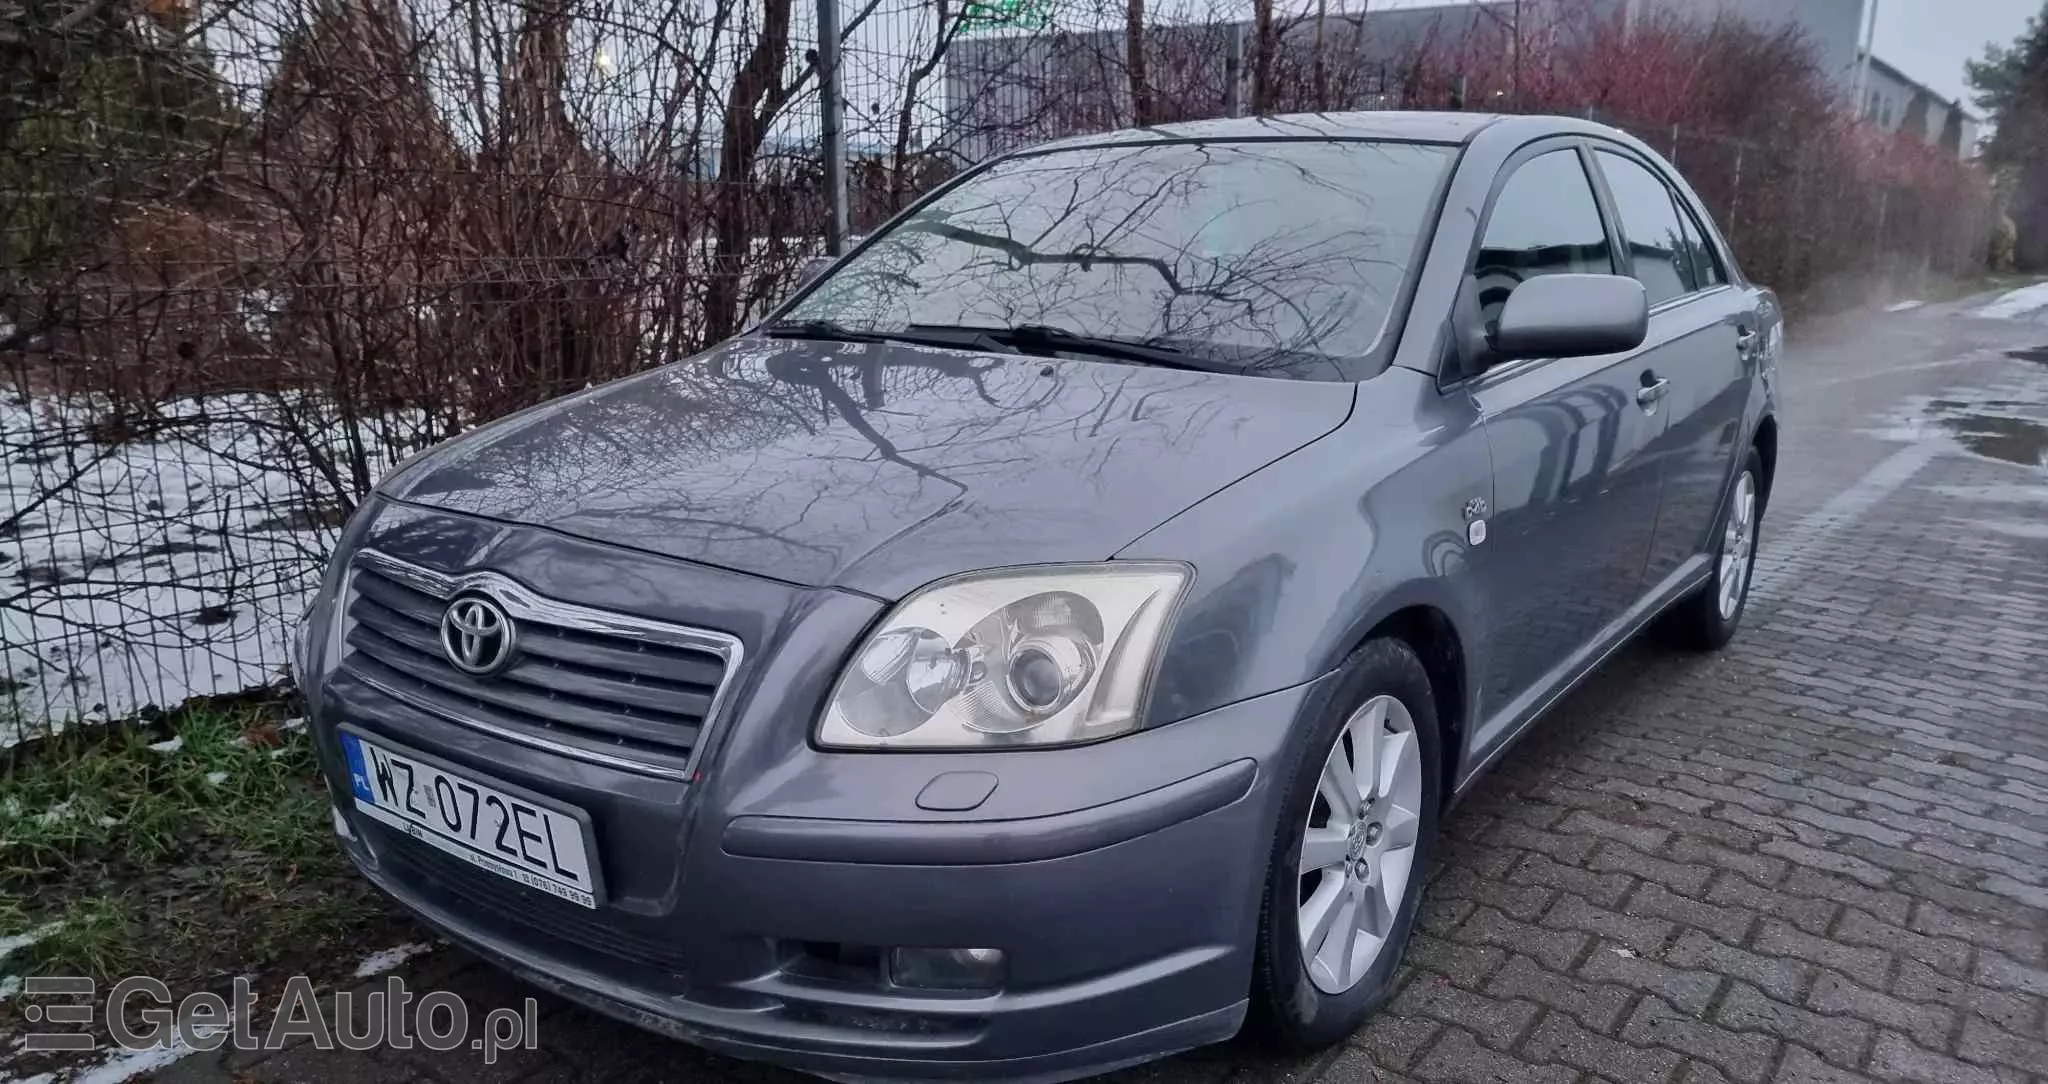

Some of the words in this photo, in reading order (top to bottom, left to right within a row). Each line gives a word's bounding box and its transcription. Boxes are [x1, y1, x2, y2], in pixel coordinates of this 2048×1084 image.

[353, 773, 371, 792] PL
[368, 747, 426, 819] WZ
[434, 775, 578, 881] 072EL
